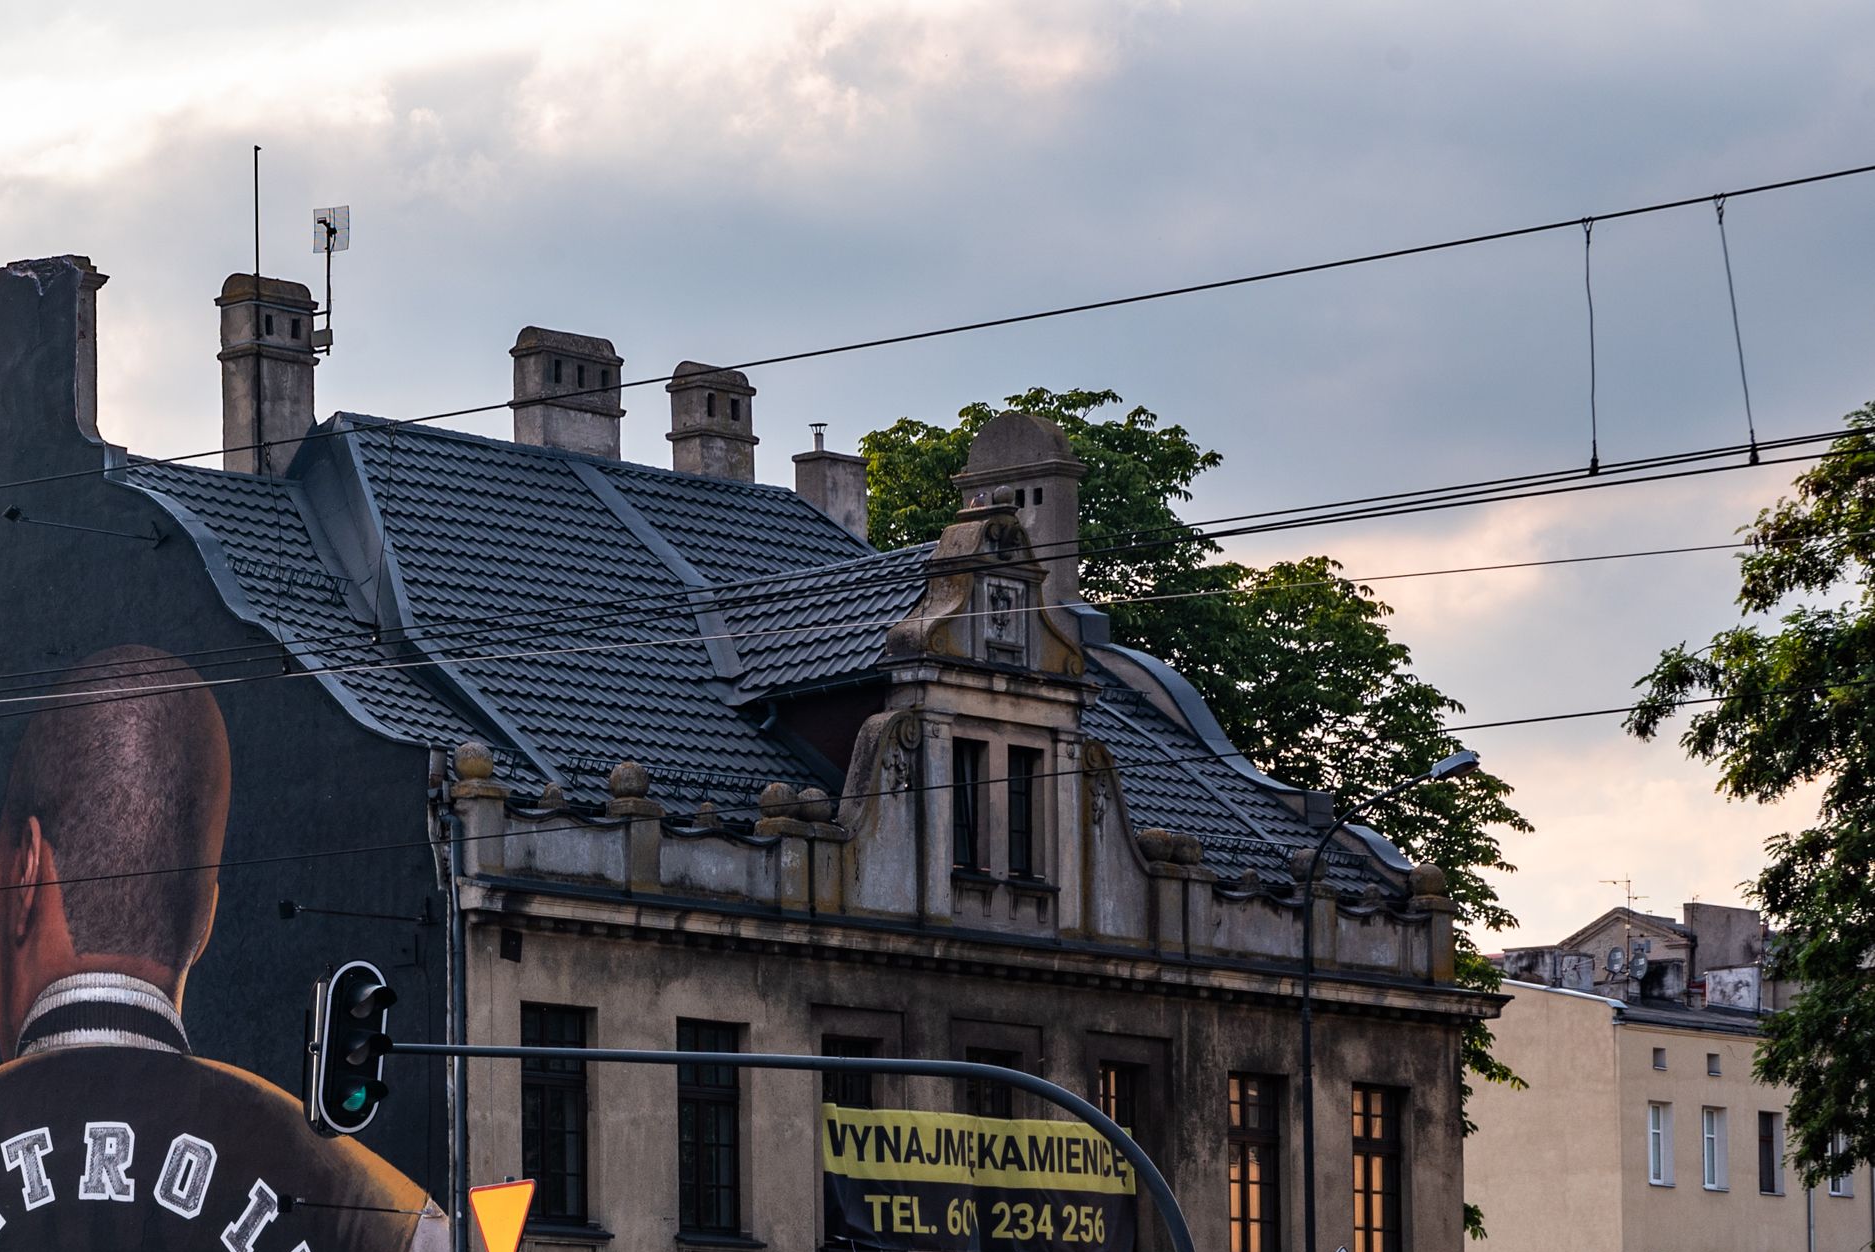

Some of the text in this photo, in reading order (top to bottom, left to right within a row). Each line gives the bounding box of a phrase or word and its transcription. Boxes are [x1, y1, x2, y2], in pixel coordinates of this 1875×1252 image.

[864, 1194, 1106, 1244] TEL. 60 234 256
